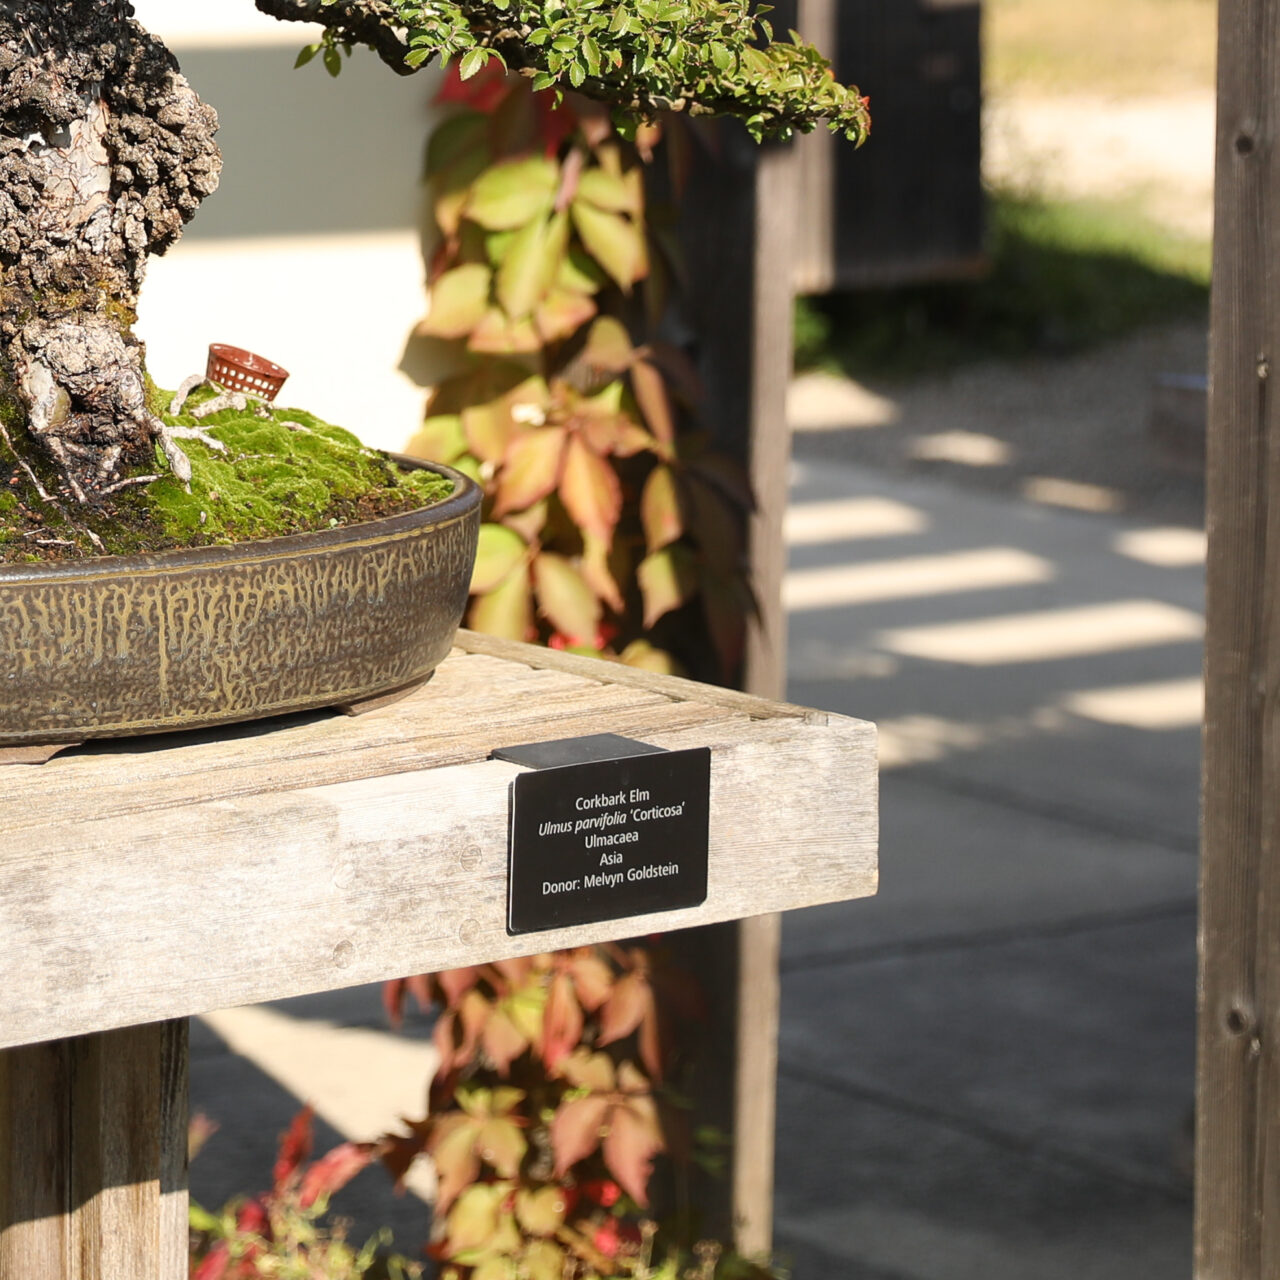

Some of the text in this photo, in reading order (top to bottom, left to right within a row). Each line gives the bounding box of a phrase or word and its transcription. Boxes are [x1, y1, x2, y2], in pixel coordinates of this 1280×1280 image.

[576, 789, 650, 810] Corkbark Elm
[538, 821, 572, 836] Ulmus
[575, 811, 626, 833] parvifolia
[585, 830, 639, 848] Ulmacaea
[599, 851, 623, 866] Asia
[542, 862, 679, 895] Donor: Melvyn Goldstein
